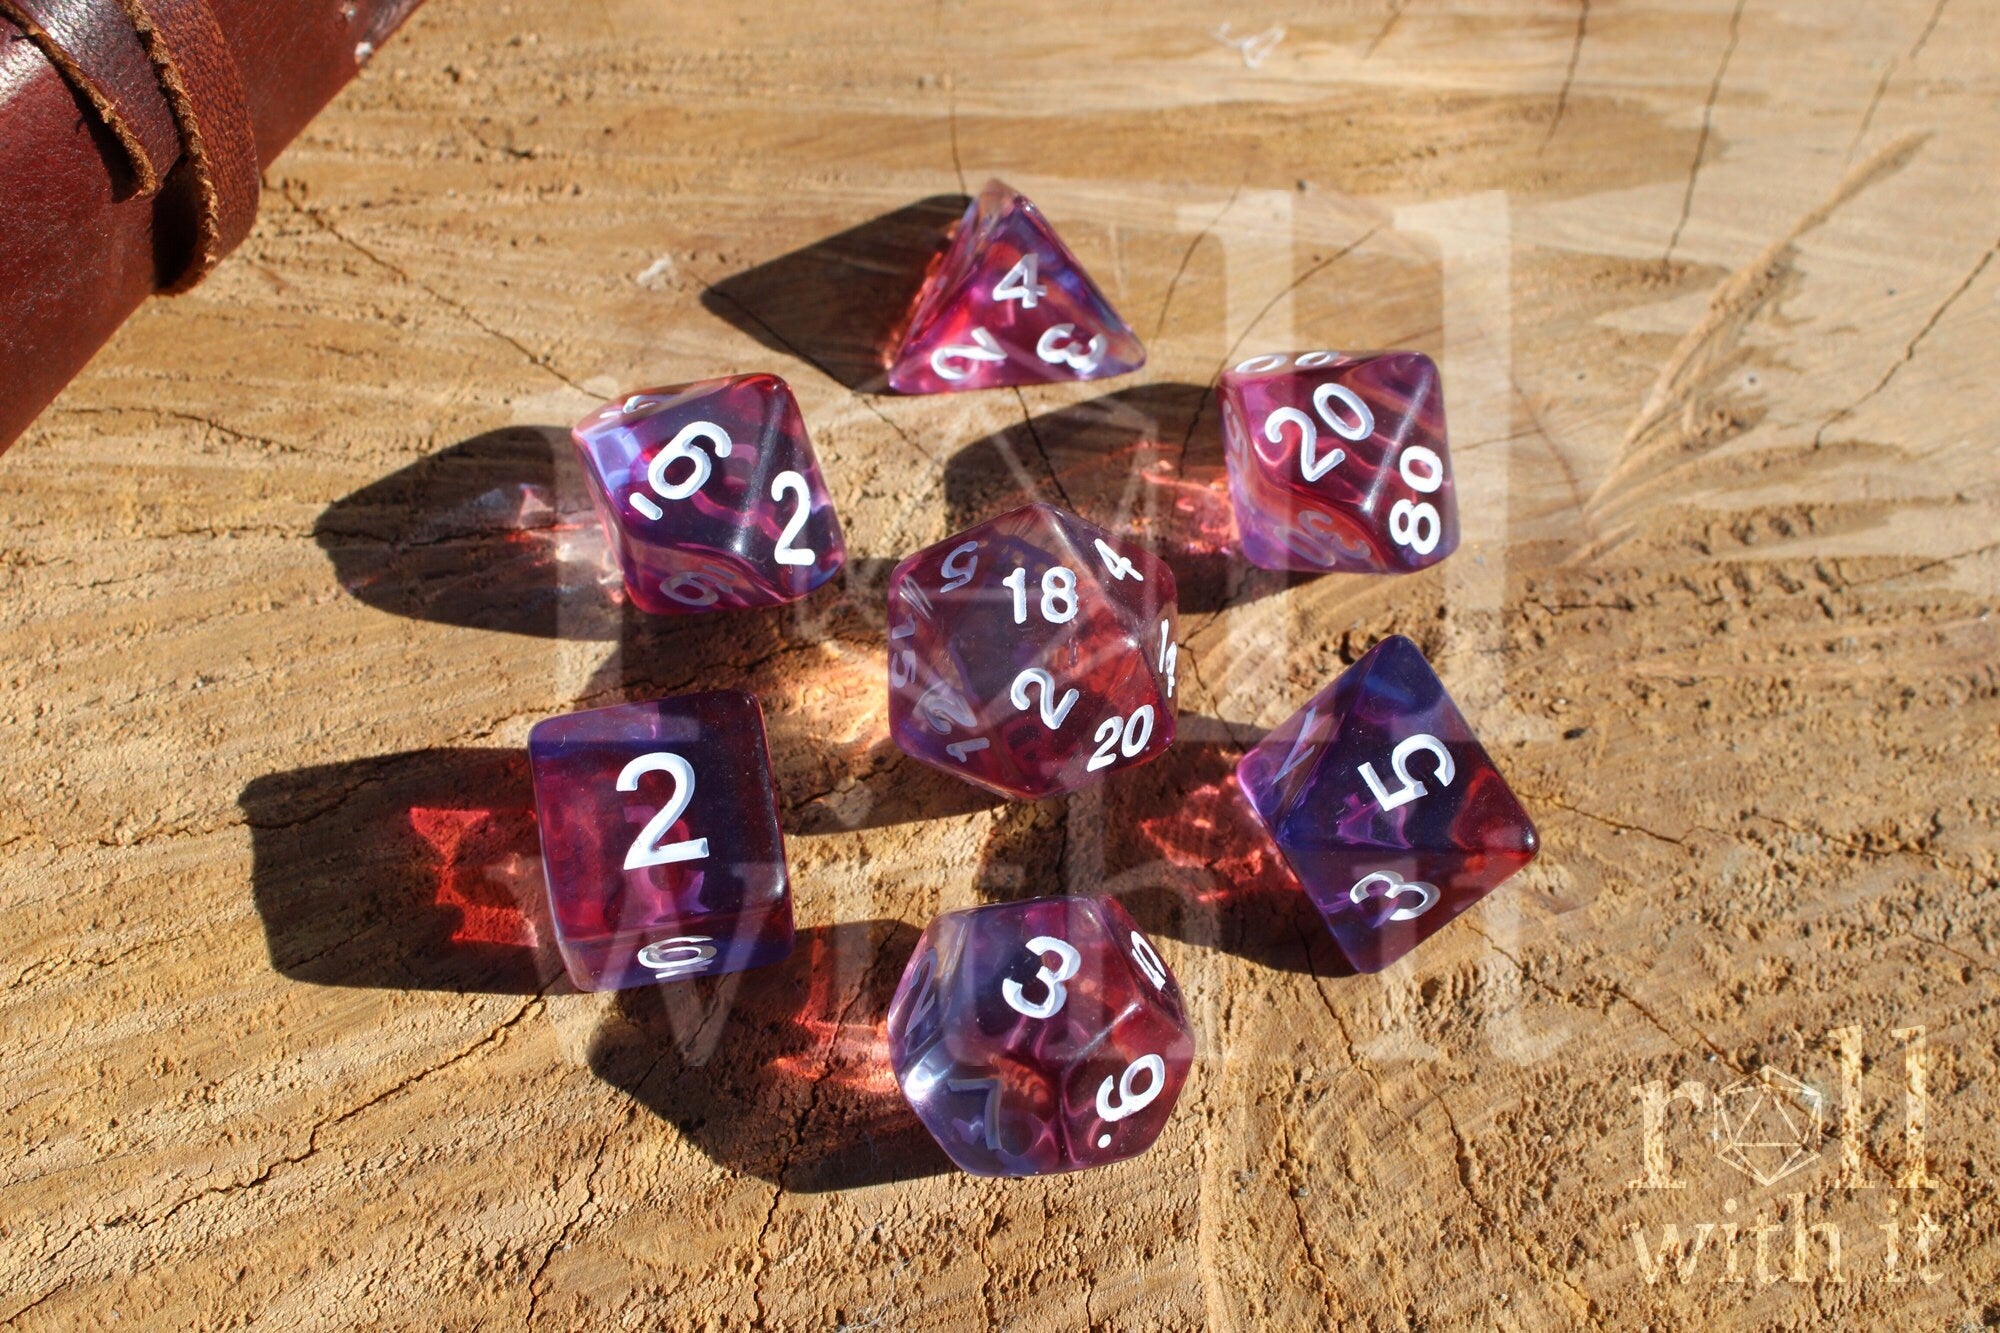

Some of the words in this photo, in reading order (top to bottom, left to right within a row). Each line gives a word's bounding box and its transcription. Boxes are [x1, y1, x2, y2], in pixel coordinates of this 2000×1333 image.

[993, 253, 1047, 308] 4
[1037, 323, 1106, 373] 3
[1265, 383, 1375, 482] 20
[771, 471, 815, 565] 2
[1389, 446, 1443, 555] 80
[1095, 539, 1143, 581] 4
[1003, 567, 1078, 624] 18
[1011, 668, 1079, 729] 2
[1087, 705, 1154, 772] 20
[1357, 733, 1455, 811] 5
[616, 752, 709, 870] 2
[1350, 870, 1440, 920] 3
[1002, 936, 1081, 1018] 3
